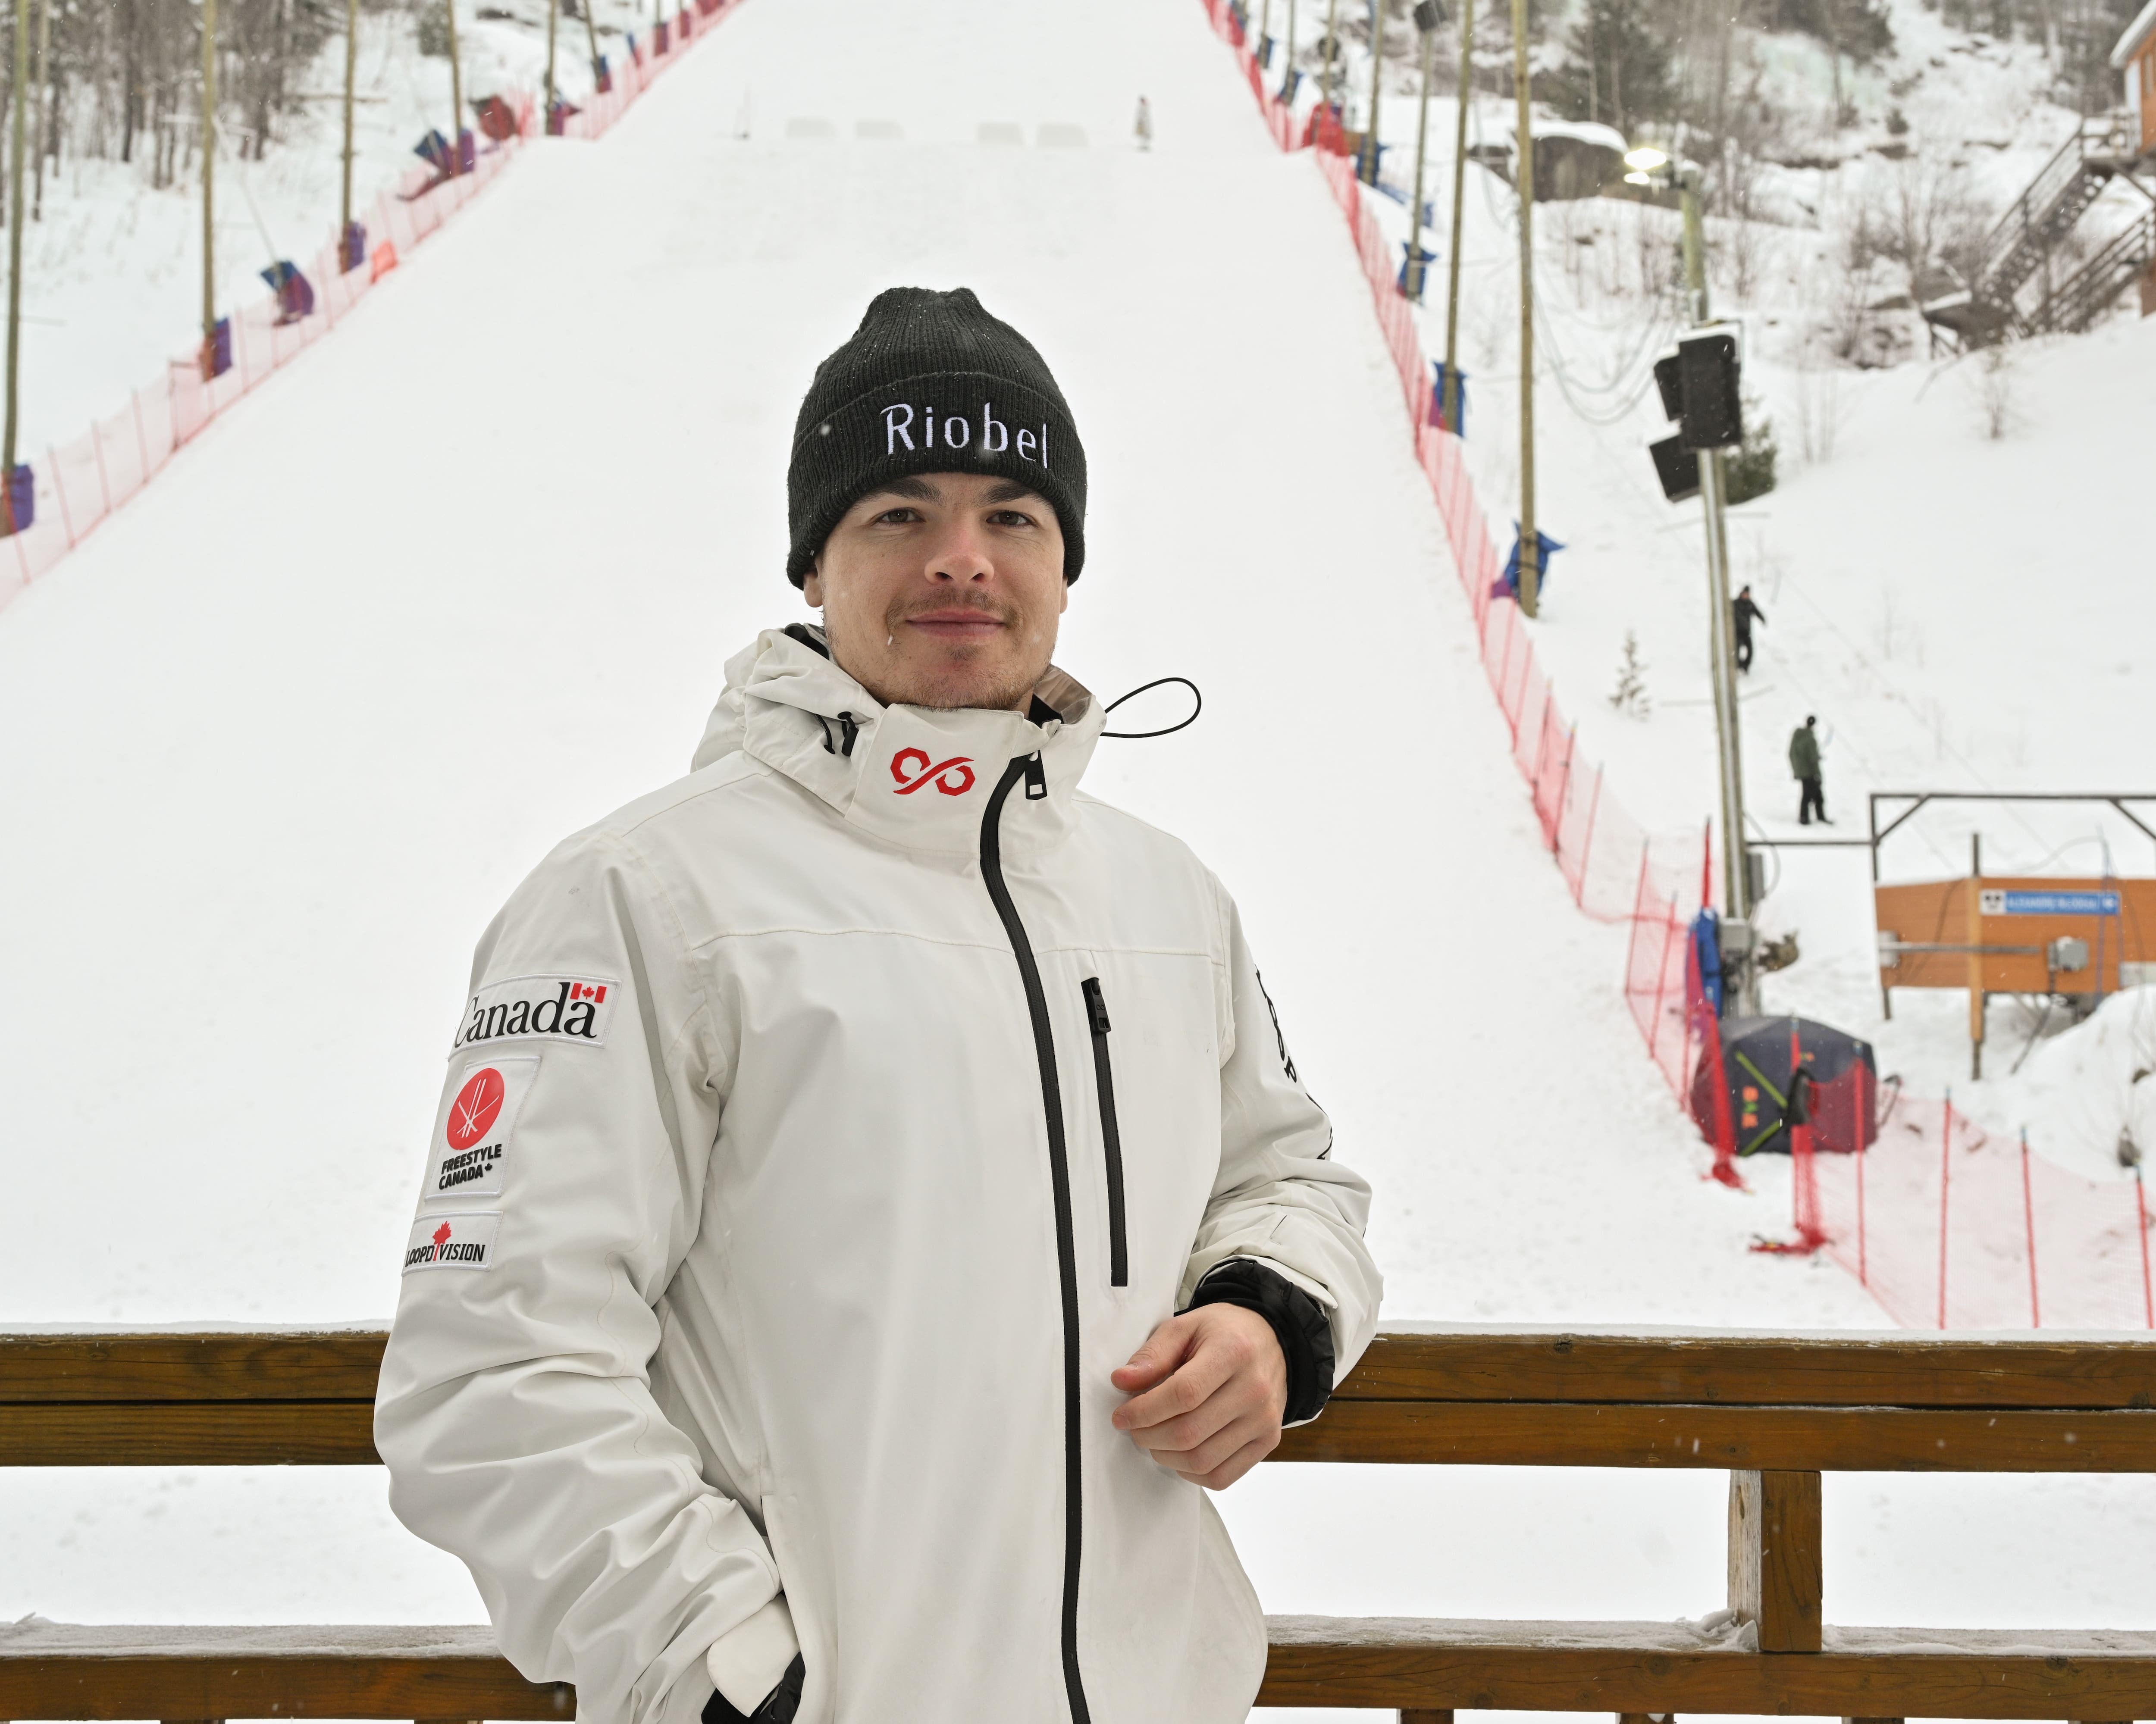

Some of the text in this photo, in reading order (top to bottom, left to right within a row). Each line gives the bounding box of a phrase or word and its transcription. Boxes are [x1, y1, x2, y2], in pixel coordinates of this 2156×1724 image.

[880, 402, 1047, 469] Riobel
[454, 982, 597, 1048] Canada
[439, 1164, 483, 1190] CANADA
[441, 1143, 502, 1175] FREESTYLE
